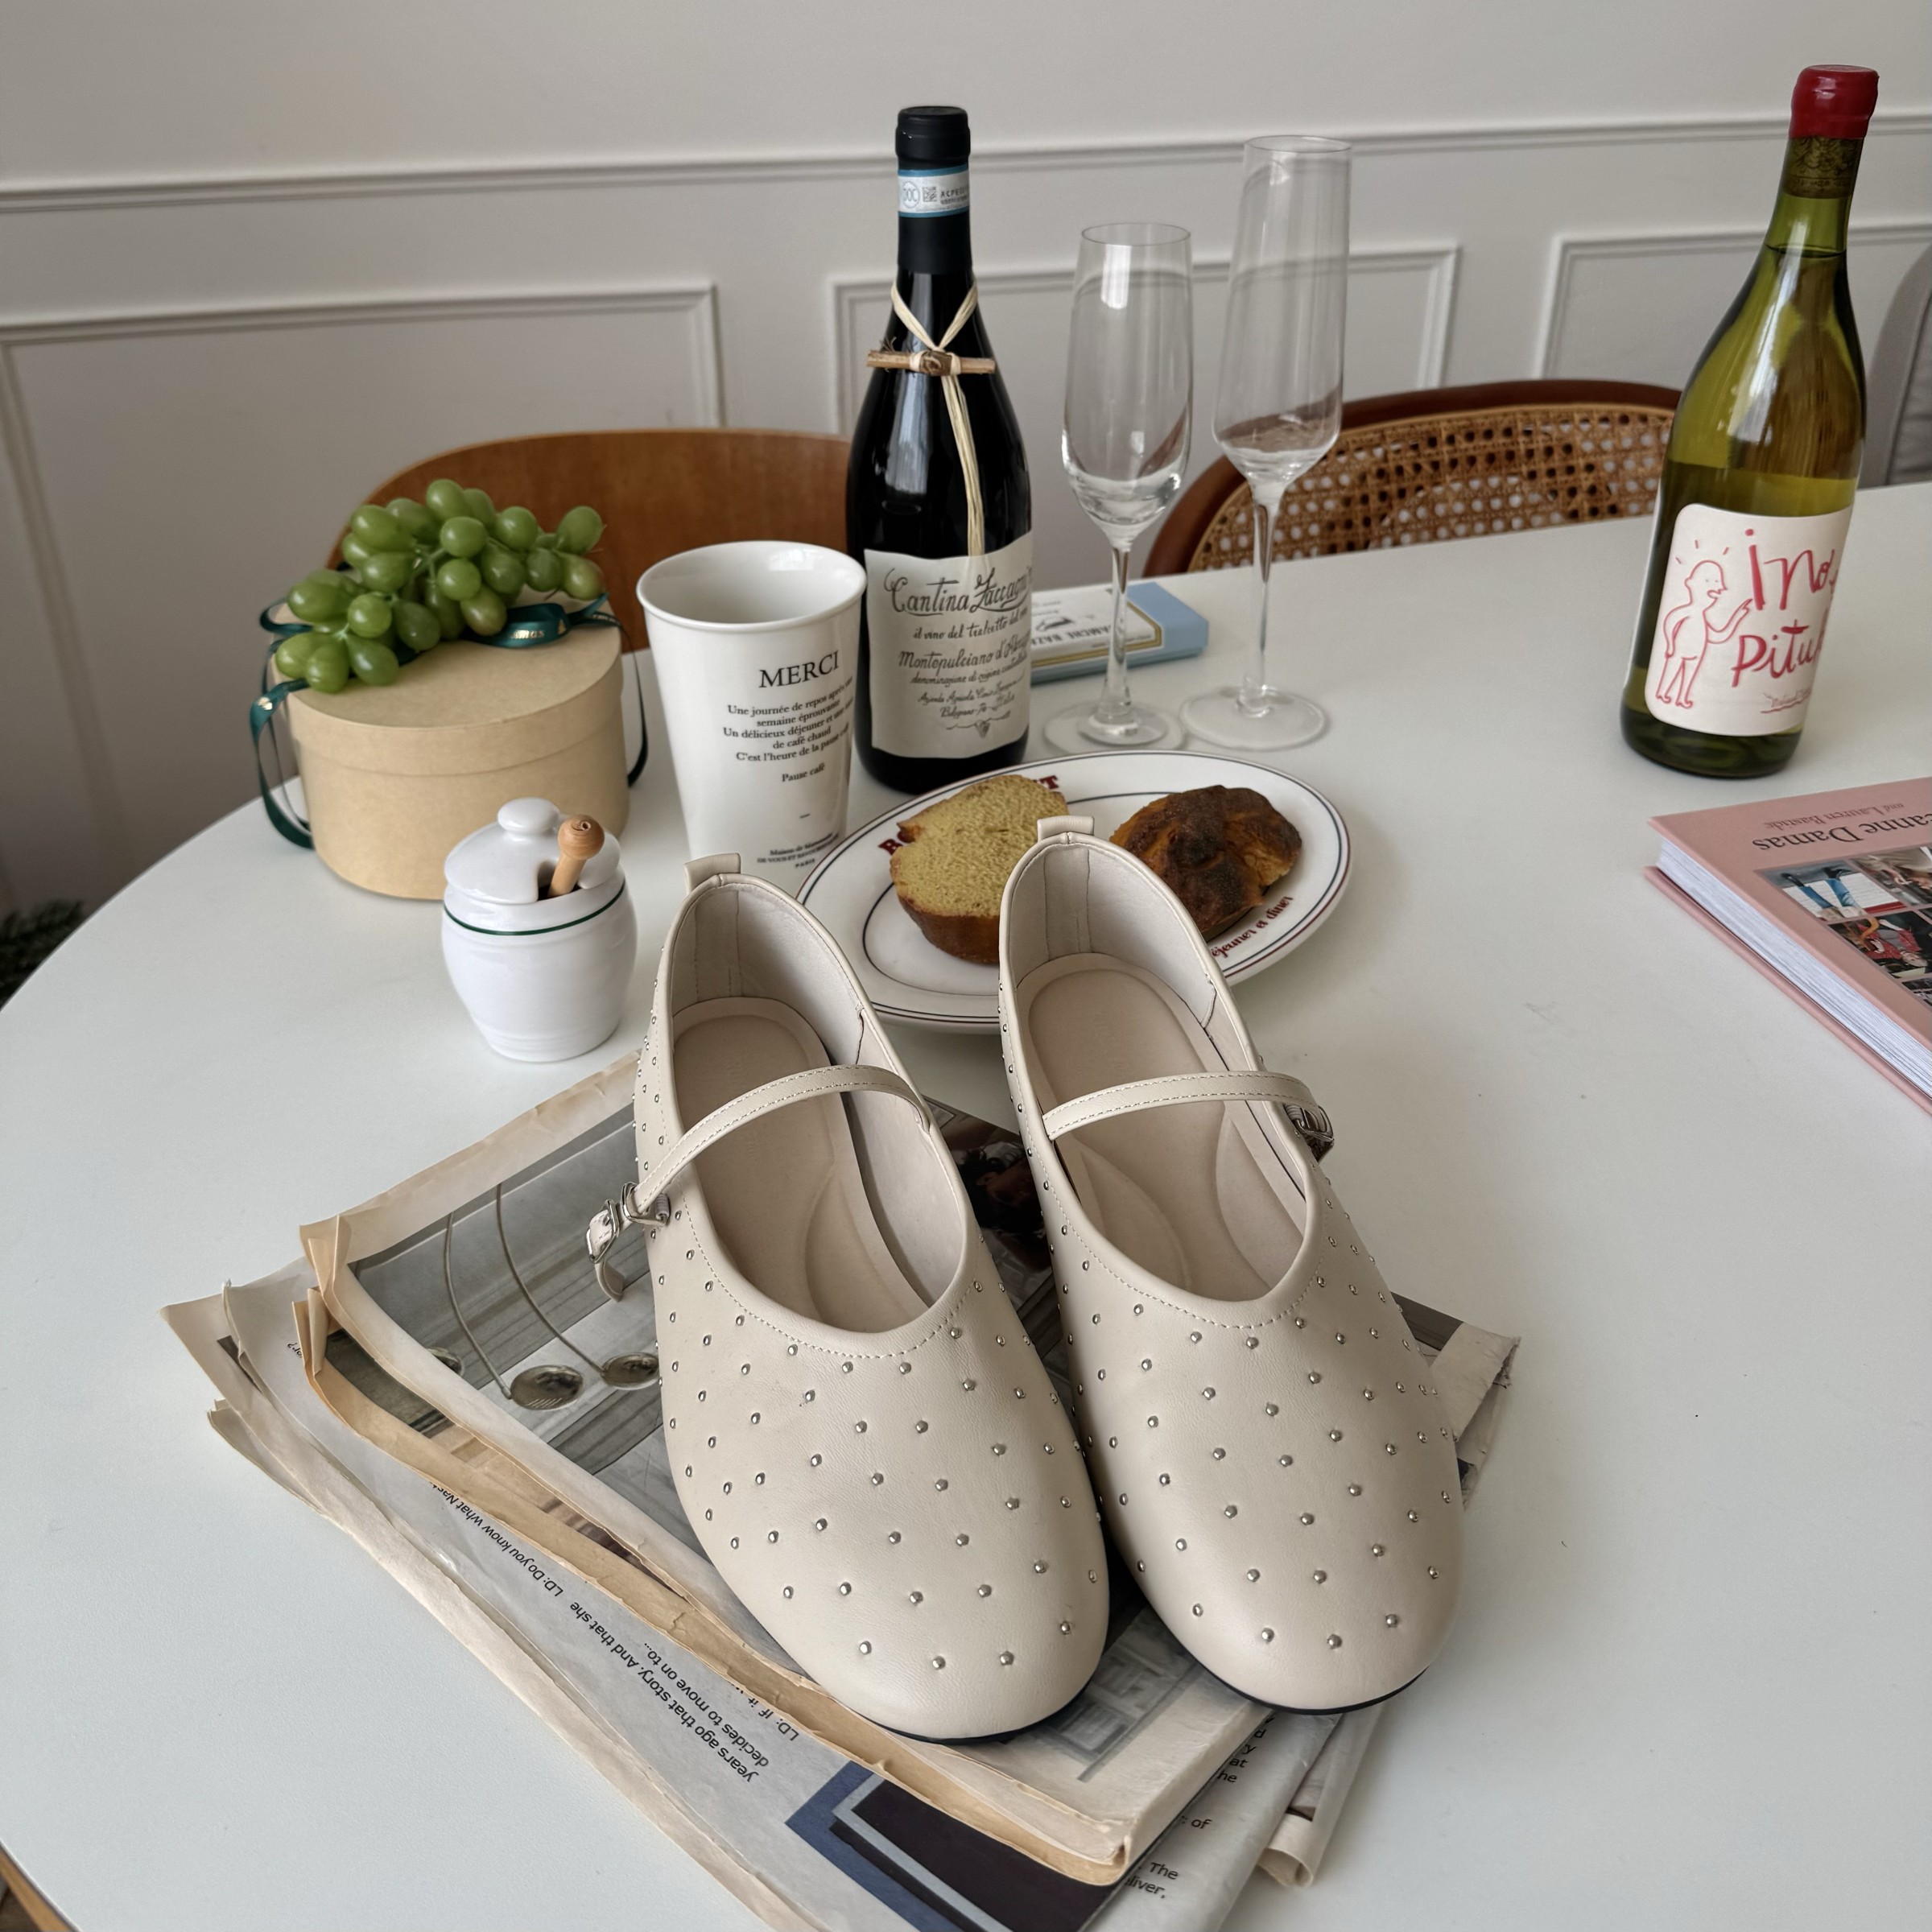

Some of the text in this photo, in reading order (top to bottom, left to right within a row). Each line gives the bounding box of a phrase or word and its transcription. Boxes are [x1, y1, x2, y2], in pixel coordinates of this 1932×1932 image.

[884, 568, 969, 617] Cantina
[758, 650, 839, 688] MERCI
[898, 649, 994, 676] Montepulciano
[728, 704, 749, 715] Une
[750, 705, 791, 717] journée
[792, 702, 803, 712] de
[806, 695, 828, 708] repos
[757, 715, 796, 727] semaine
[799, 700, 840, 723] éprouvante
[724, 727, 739, 737] Un
[741, 729, 785, 738] délicieux
[787, 719, 825, 736] déjeuner
[773, 725, 831, 749] de café chaud
[736, 752, 761, 762] C'est
[764, 752, 797, 762] l'heure
[799, 746, 810, 757] de
[812, 743, 819, 753] la
[782, 762, 825, 782] Pause café
[1823, 807, 1885, 820] Lauren
[1751, 825, 1865, 850] Damas
[1211, 929, 1257, 958] éjeuner
[456, 1502, 484, 1527] what
[481, 1525, 512, 1552] know
[510, 1547, 535, 1567] you
[528, 1564, 545, 1581] Do
[543, 1577, 564, 1597] LD:
[644, 1642, 663, 1666] to...
[661, 1662, 678, 1681] on
[570, 1601, 759, 1783] years ago that story. And that she
[676, 1679, 709, 1712] move
[707, 1711, 723, 1726] to
[758, 1707, 774, 1720] If
[776, 1718, 799, 1742] LD:
[721, 1724, 769, 1768] decides
[1191, 1818, 1212, 1830] of
[1150, 1862, 1179, 1880] The
[1125, 1876, 1166, 1899] liver,
